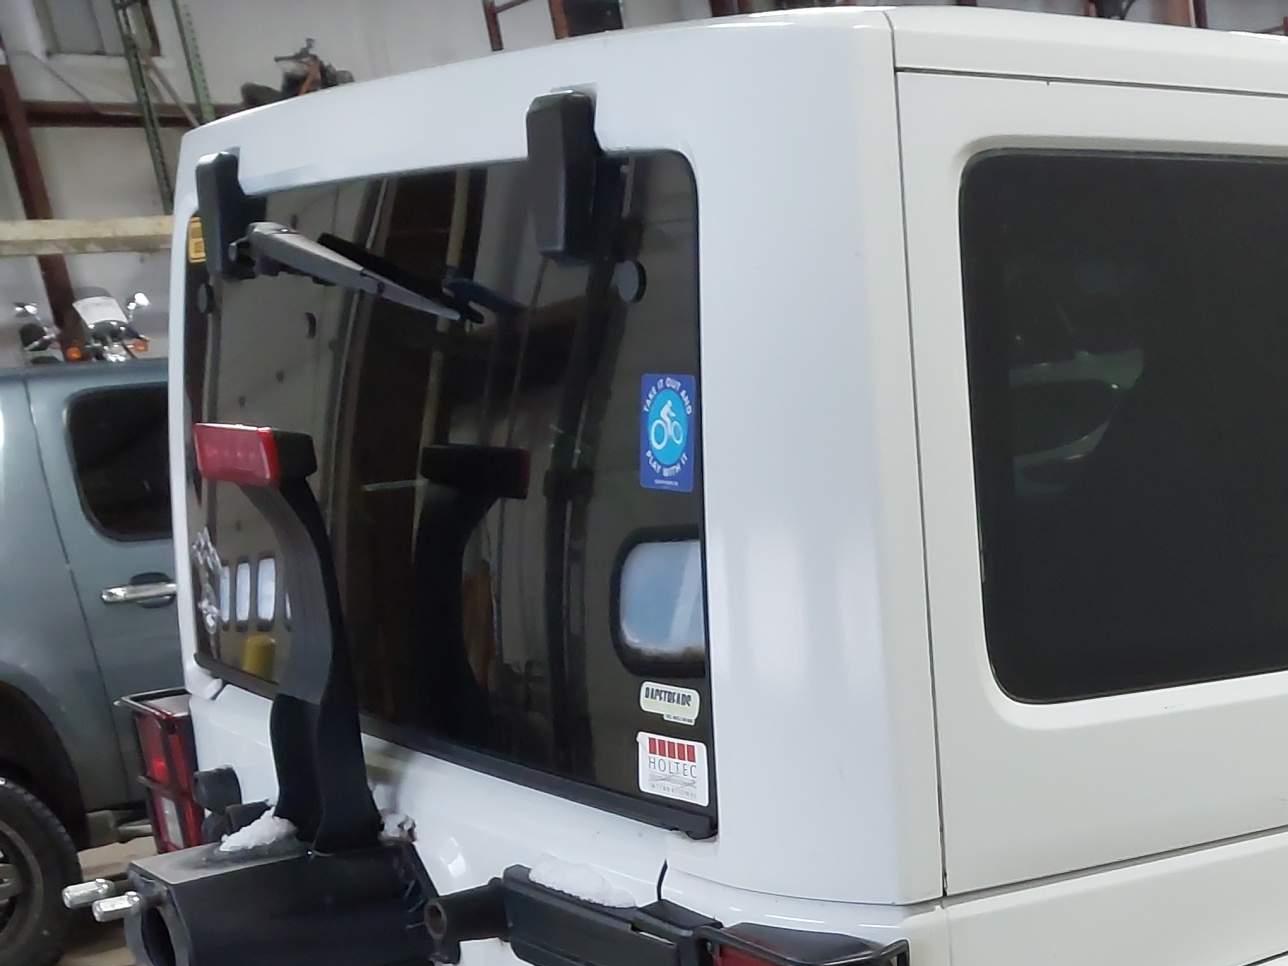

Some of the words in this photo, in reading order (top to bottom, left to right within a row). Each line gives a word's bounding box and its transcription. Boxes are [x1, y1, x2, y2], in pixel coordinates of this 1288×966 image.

[644, 386, 657, 412] TAKE
[657, 378, 664, 390] IT
[665, 377, 681, 390] OUT
[680, 389, 692, 415] AND
[646, 450, 661, 474] PLAY
[662, 463, 681, 477] WITH
[680, 453, 688, 465] IT
[648, 756, 697, 779] HOLTEC
